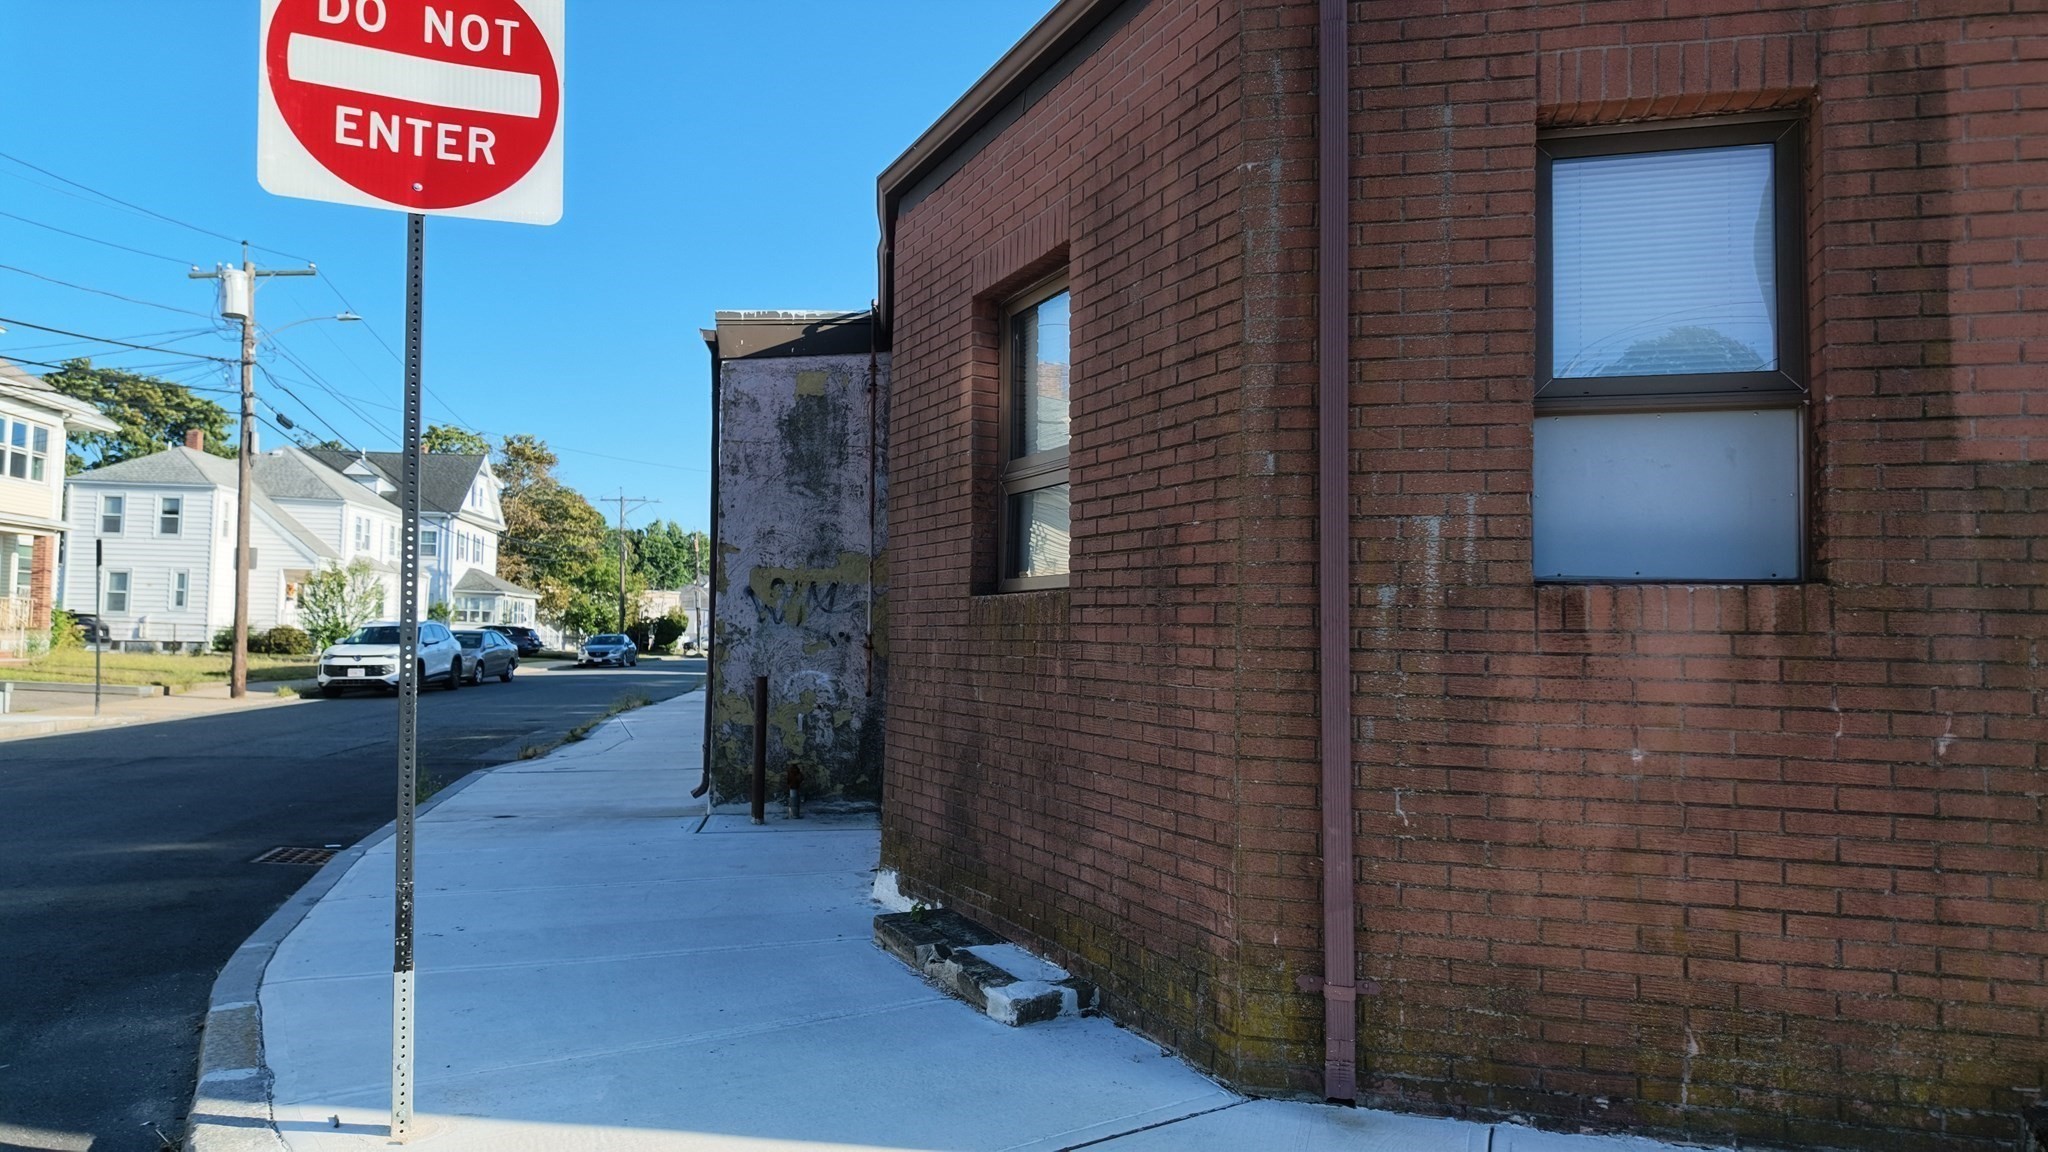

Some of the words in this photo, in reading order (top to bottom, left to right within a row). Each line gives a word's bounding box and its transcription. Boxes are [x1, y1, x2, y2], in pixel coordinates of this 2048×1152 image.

[318, 0, 387, 33] DO
[424, 6, 520, 56] NOT
[335, 105, 496, 165] ENTER
